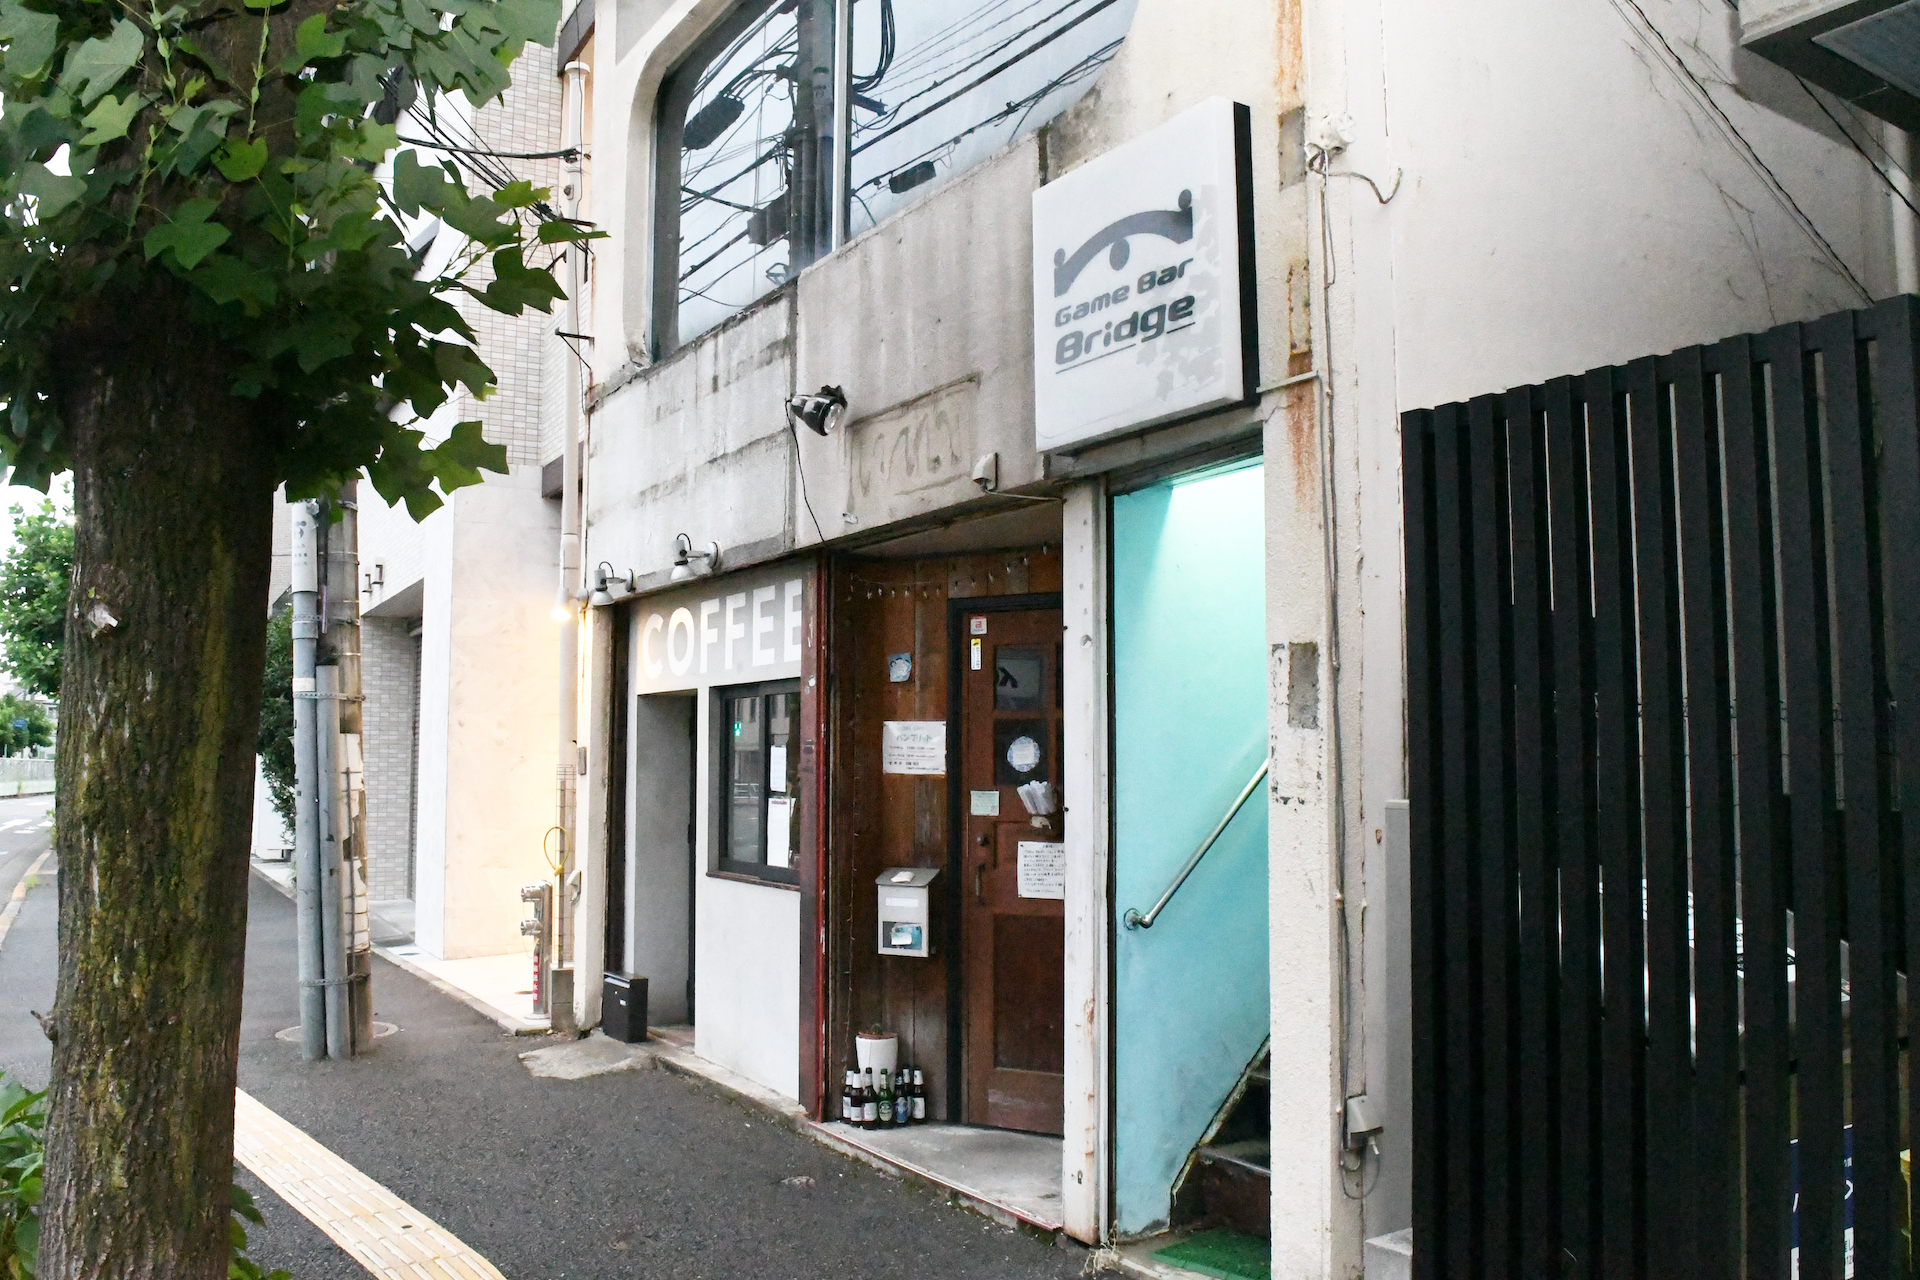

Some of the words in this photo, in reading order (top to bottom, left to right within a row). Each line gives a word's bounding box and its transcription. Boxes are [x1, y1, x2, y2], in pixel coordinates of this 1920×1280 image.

[1055, 285, 1130, 327] Game
[1137, 258, 1194, 294] Bar
[1055, 295, 1195, 364] Bridge
[642, 578, 802, 680] COFFEE
